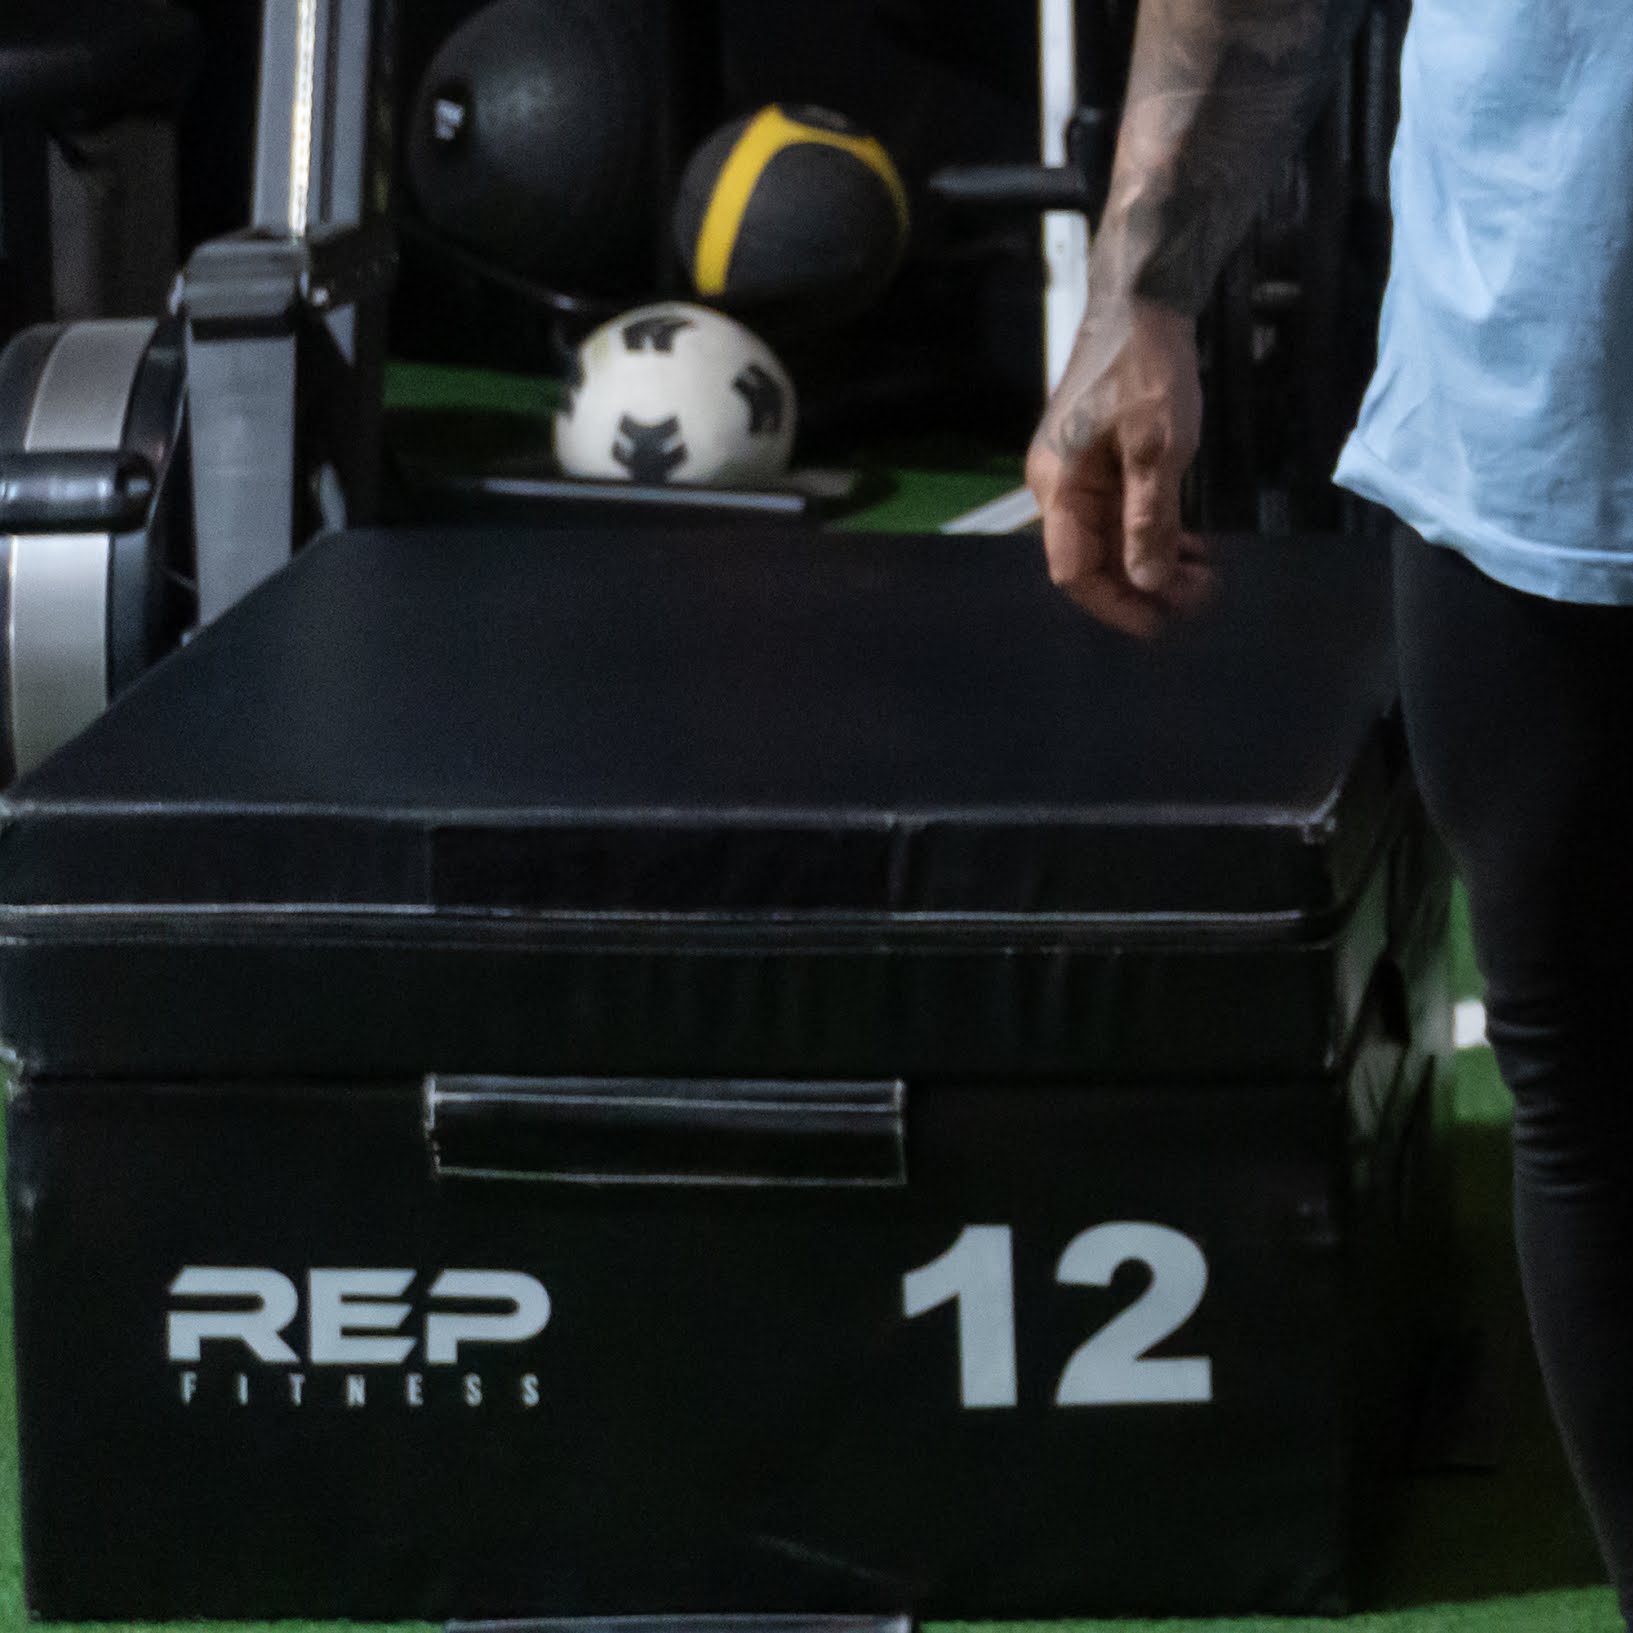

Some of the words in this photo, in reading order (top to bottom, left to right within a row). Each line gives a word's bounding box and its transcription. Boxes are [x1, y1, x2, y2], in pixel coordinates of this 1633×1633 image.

[166, 1265, 551, 1365] REP
[902, 1221, 1212, 1408] 12
[180, 1371, 539, 1406] FITNESS
